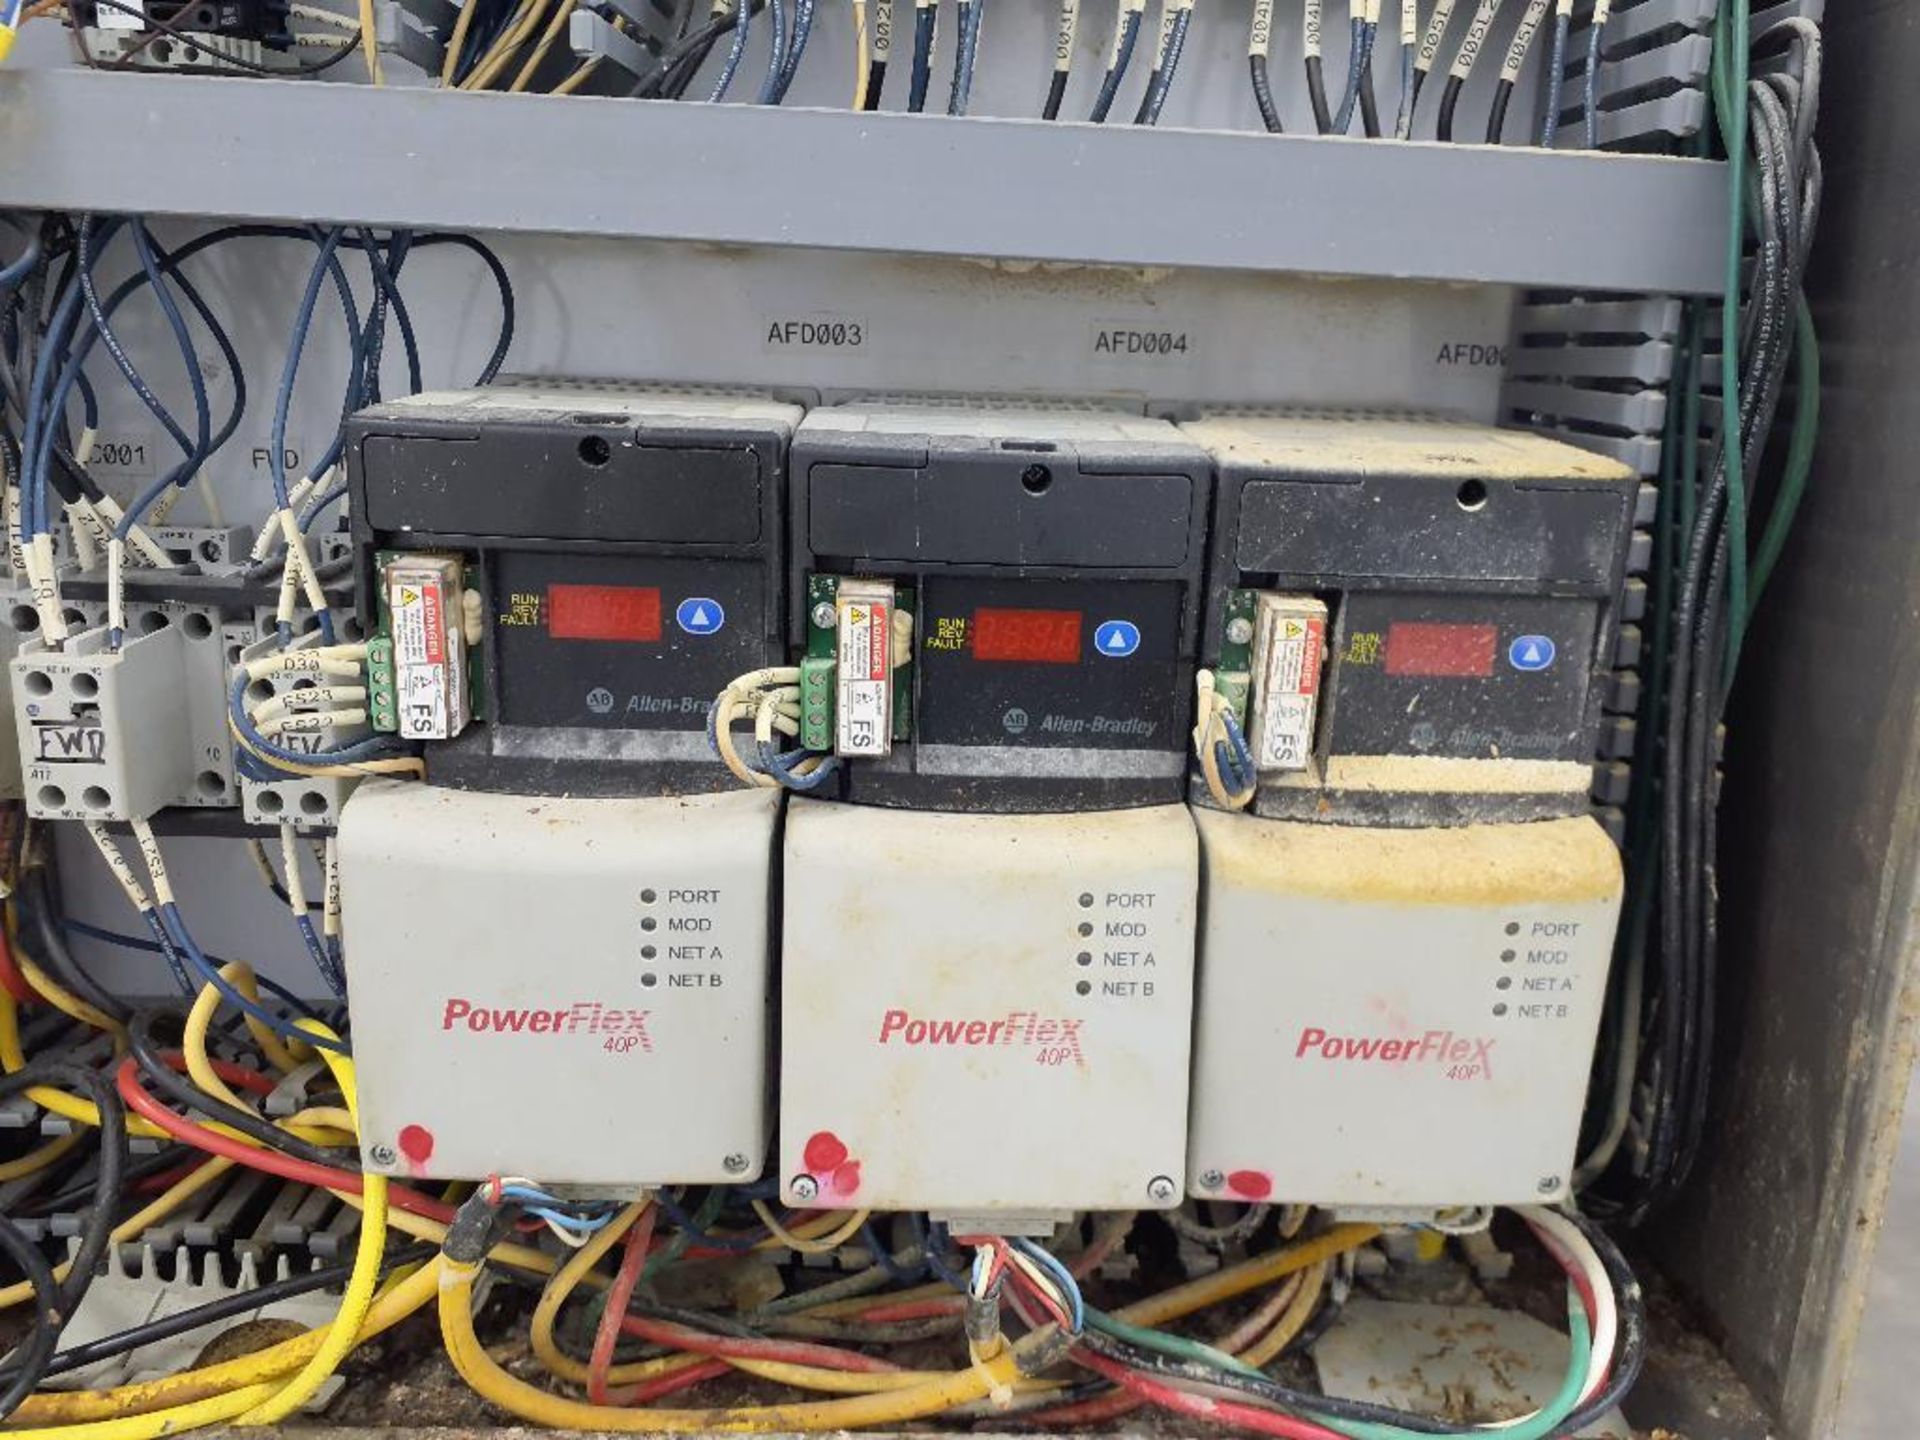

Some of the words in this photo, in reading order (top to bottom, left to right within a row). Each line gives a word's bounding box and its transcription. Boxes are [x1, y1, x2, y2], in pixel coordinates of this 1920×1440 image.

[768, 322, 862, 346] AFD003
[1095, 331, 1188, 354] AFD004
[253, 449, 299, 470] FD
[511, 594, 539, 604] RUN
[938, 618, 965, 629] RUN
[626, 695, 712, 713] Allen-Bra
[412, 704, 433, 733] FS
[1040, 714, 1158, 738] Allen-Bradley
[852, 720, 871, 748] FS
[38, 727, 106, 760] FWD
[1274, 733, 1295, 760] FS
[668, 889, 721, 904] PORT
[1105, 893, 1156, 908] PORT
[668, 917, 712, 932] MOD
[1105, 921, 1147, 937] MOD
[1530, 921, 1581, 937] PORT
[668, 946, 706, 960] NET
[710, 945, 723, 960] A
[1103, 951, 1140, 967] NET
[1143, 951, 1157, 967] A
[1526, 949, 1569, 965] MOD
[668, 973, 706, 988] NET
[709, 973, 723, 988] B
[1102, 981, 1139, 997] NET
[1143, 981, 1155, 997] B
[1521, 977, 1557, 991] NET
[1559, 977, 1573, 991] A
[1517, 1003, 1554, 1018] NET
[1555, 1004, 1568, 1018] B
[443, 998, 653, 1053] PowerFlex
[603, 1036, 639, 1053] 40P
[879, 1009, 1085, 1067] PowerFlex
[1036, 1047, 1072, 1066] 40P
[1295, 1027, 1496, 1081] PowerFlex
[1446, 1064, 1480, 1081] 40P
